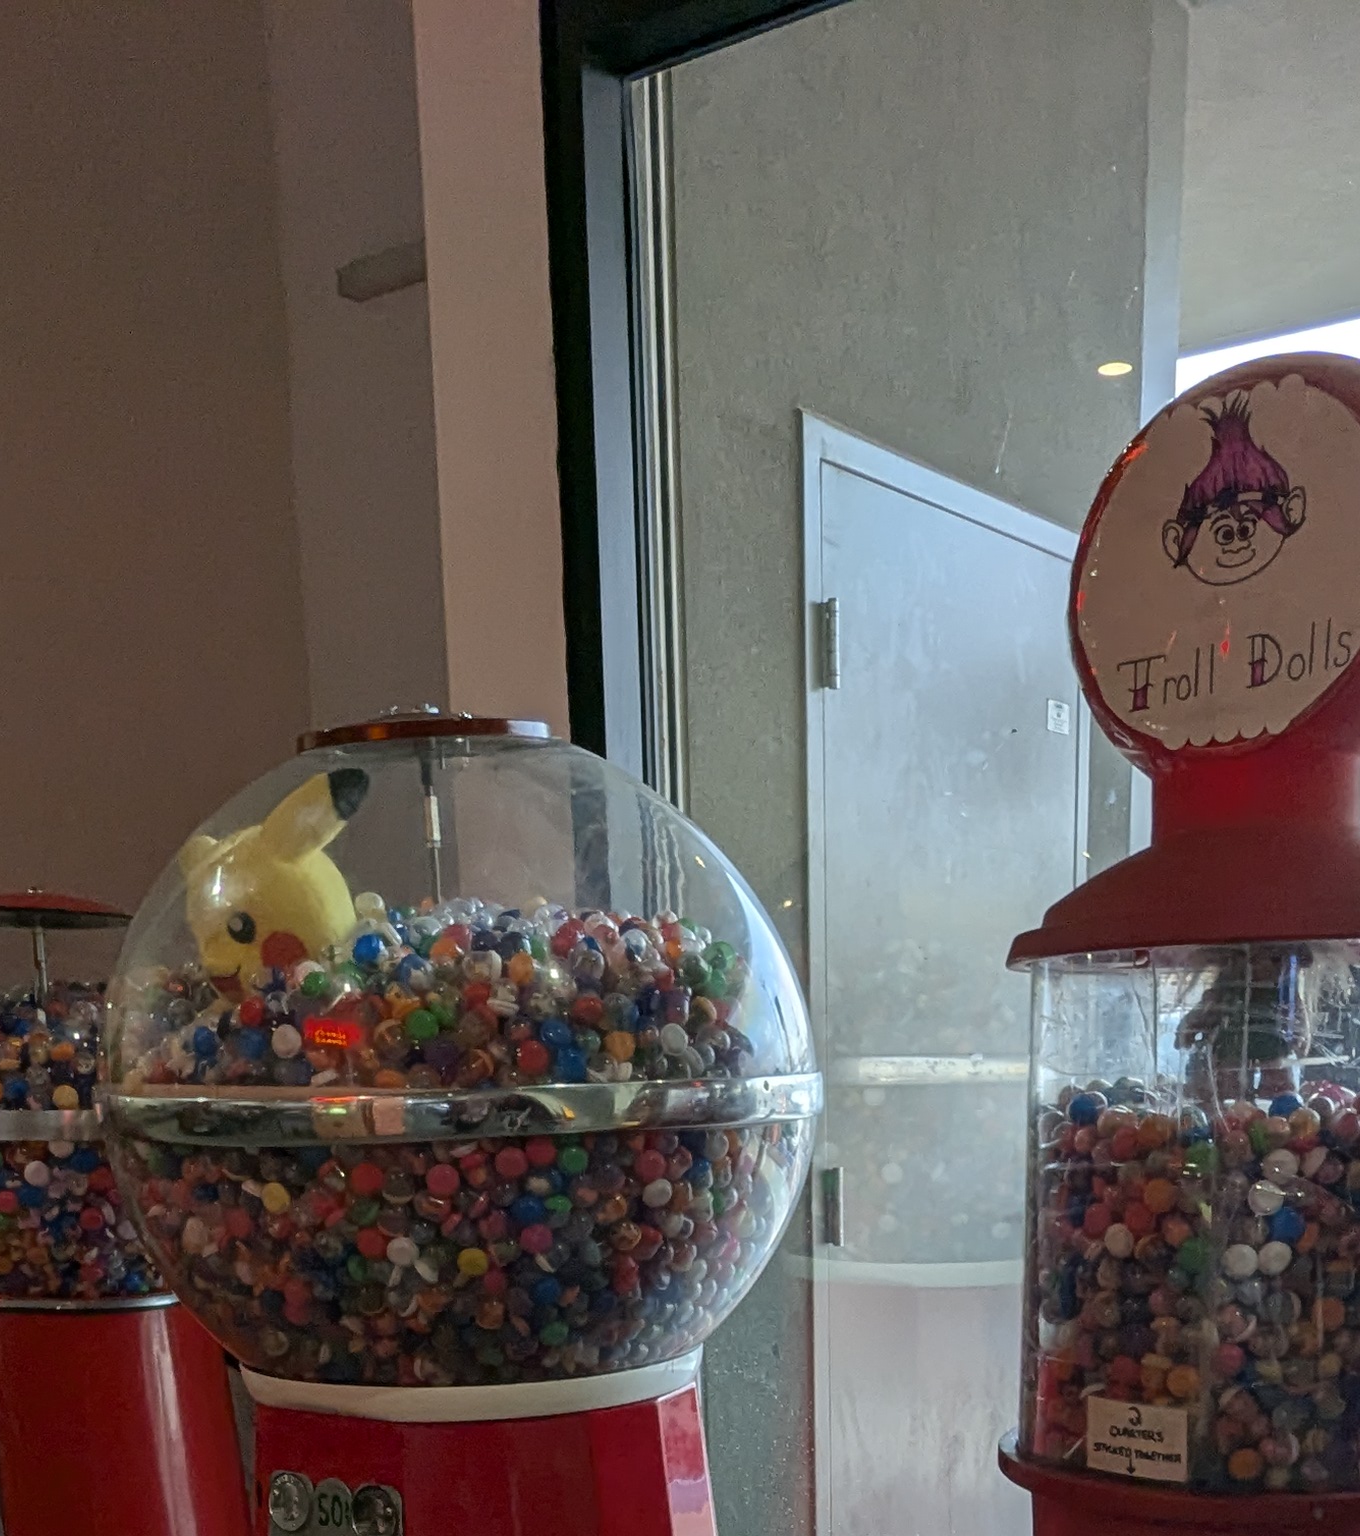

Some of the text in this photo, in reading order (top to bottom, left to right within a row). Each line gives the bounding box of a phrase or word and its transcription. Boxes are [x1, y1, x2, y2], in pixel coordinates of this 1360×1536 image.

[1117, 617, 1352, 712] Troll Dolls
[1109, 1425, 1164, 1443] QUARTERS
